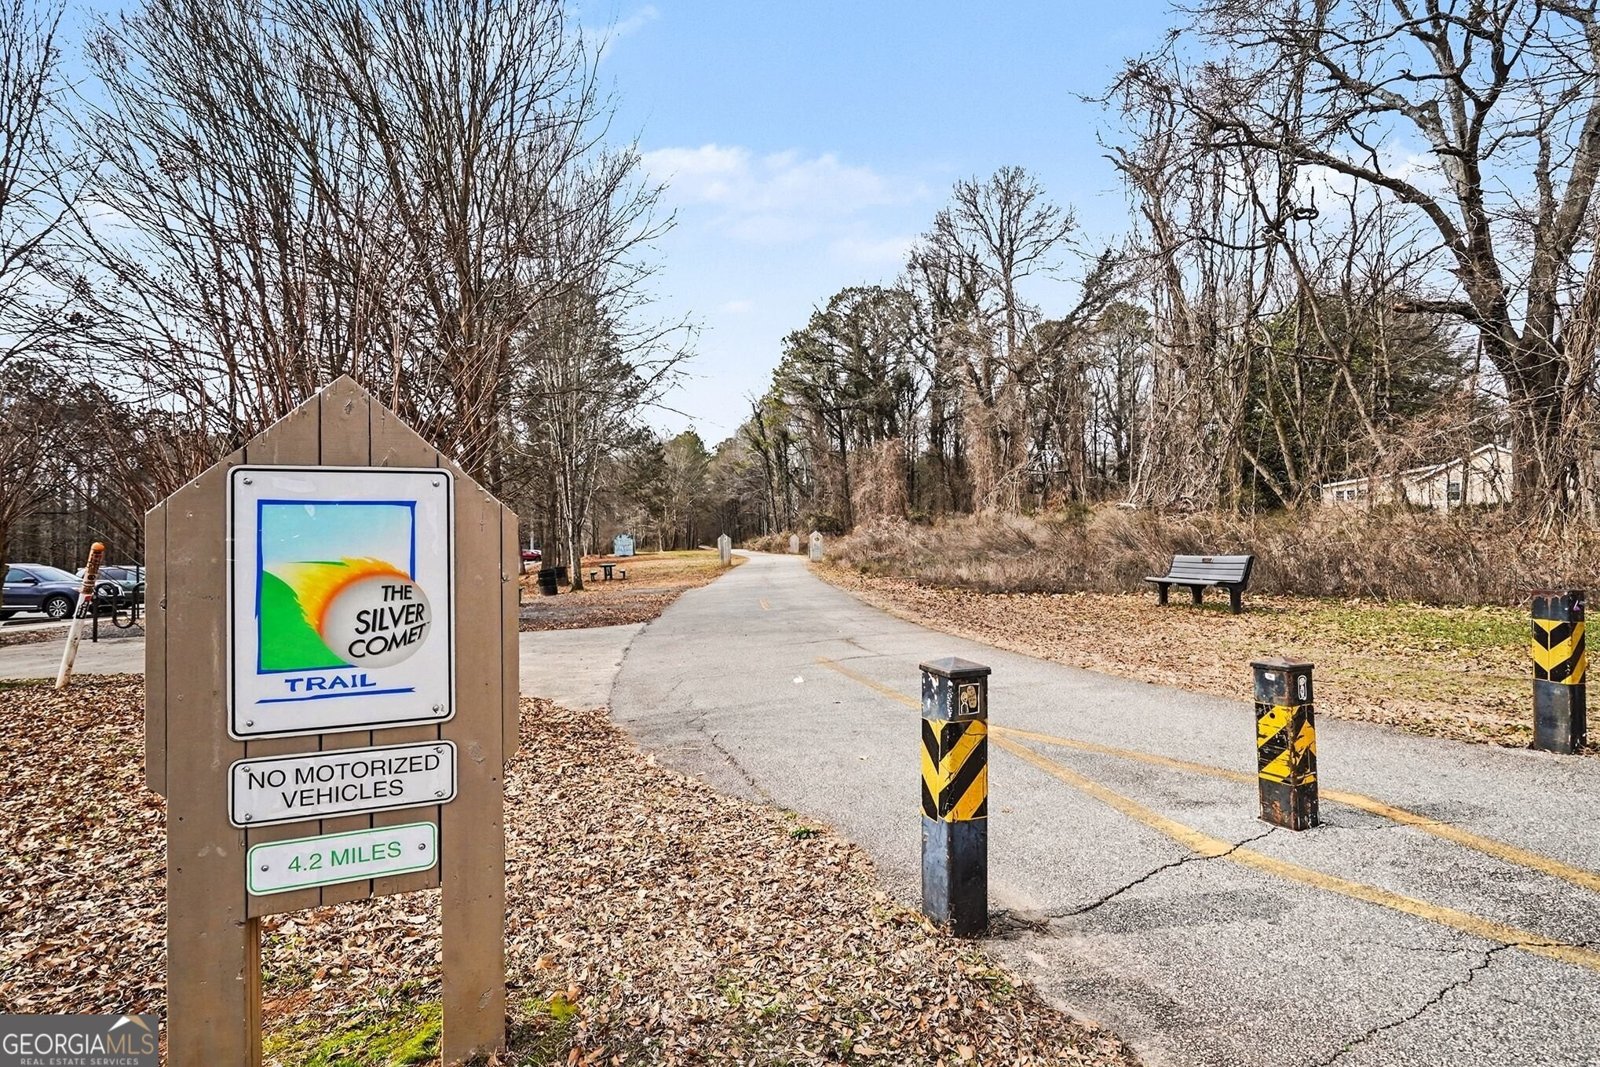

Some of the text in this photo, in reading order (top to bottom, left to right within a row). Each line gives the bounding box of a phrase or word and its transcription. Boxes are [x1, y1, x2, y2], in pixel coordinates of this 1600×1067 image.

[381, 585, 412, 602] THE
[354, 603, 425, 635] SILVER
[348, 623, 426, 658] COMET
[284, 673, 377, 692] TRAIL
[248, 754, 440, 790] NO MOTORIZED
[281, 779, 404, 808] VEHICLES
[288, 841, 402, 872] 4.2 MILES
